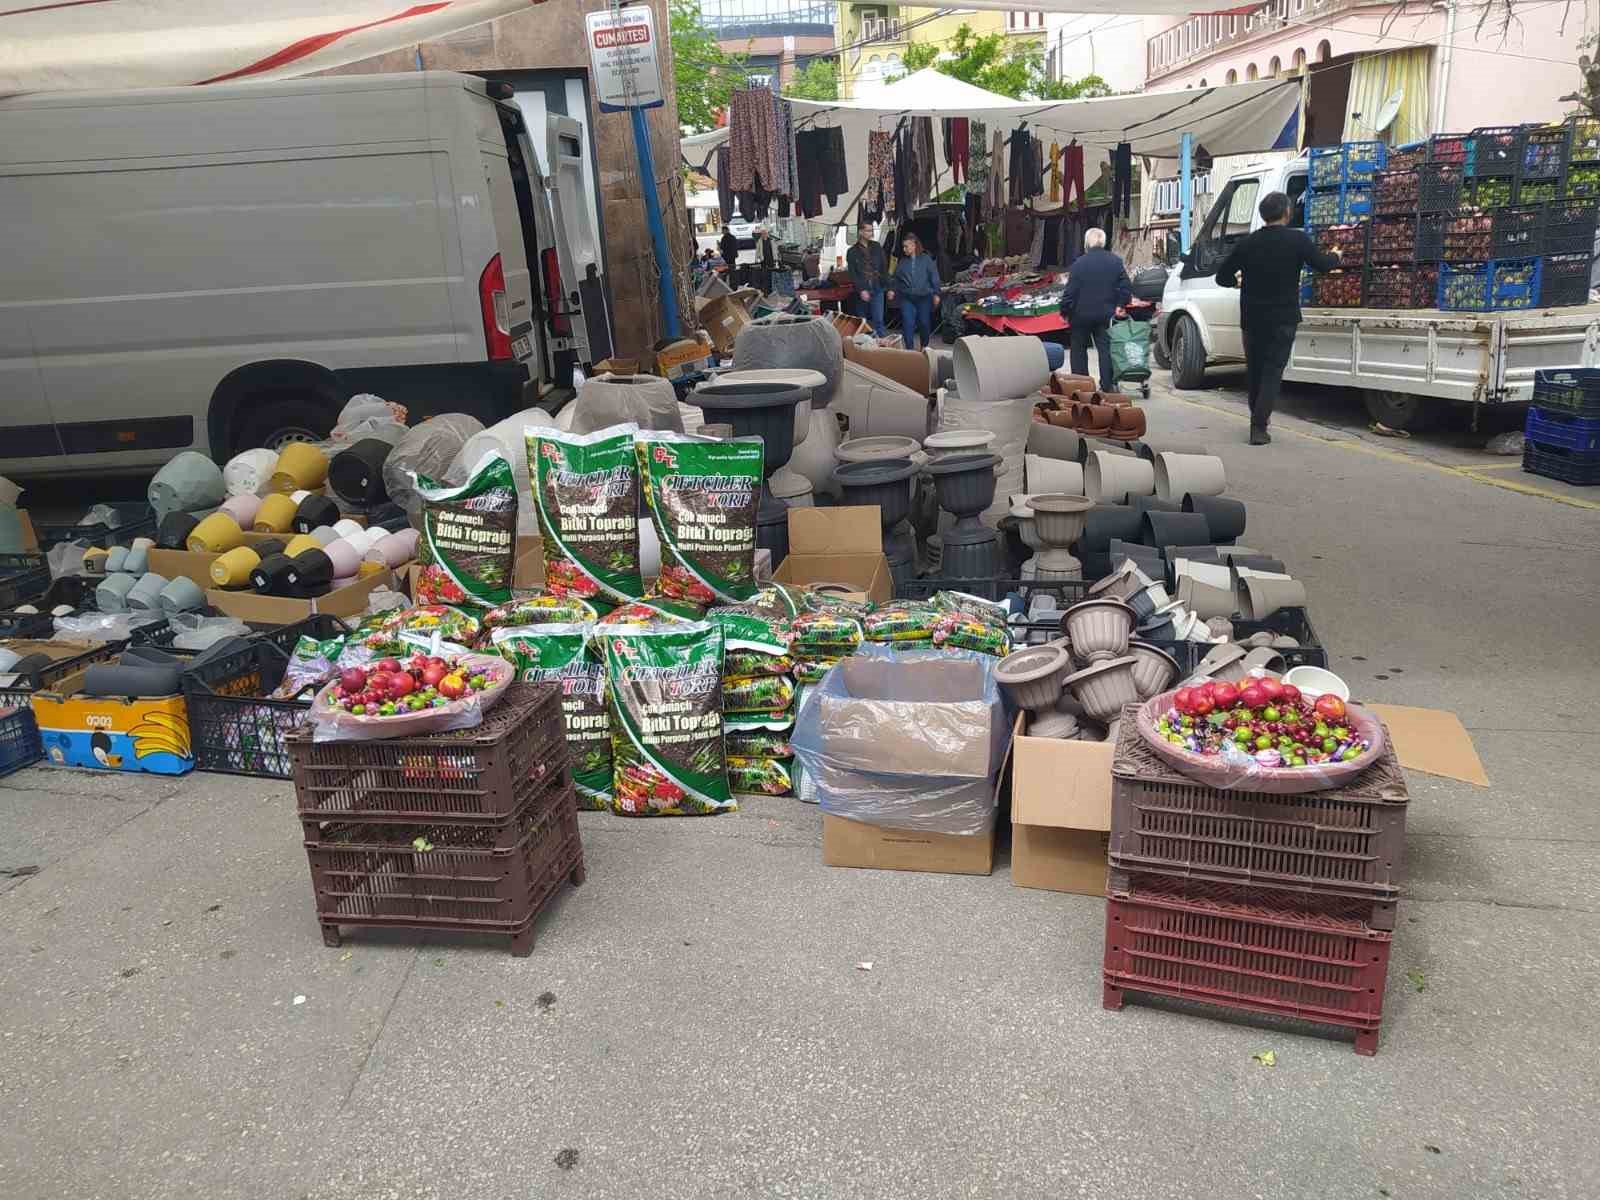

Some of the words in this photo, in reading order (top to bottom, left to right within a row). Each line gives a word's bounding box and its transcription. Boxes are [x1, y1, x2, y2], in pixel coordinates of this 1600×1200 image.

[707, 492, 752, 508] TORF
[561, 517, 587, 531] Bitki
[437, 522, 464, 539] Bitki
[464, 526, 511, 544] Toprağı
[677, 525, 706, 540] Bitki
[642, 717, 671, 732] Bitki
